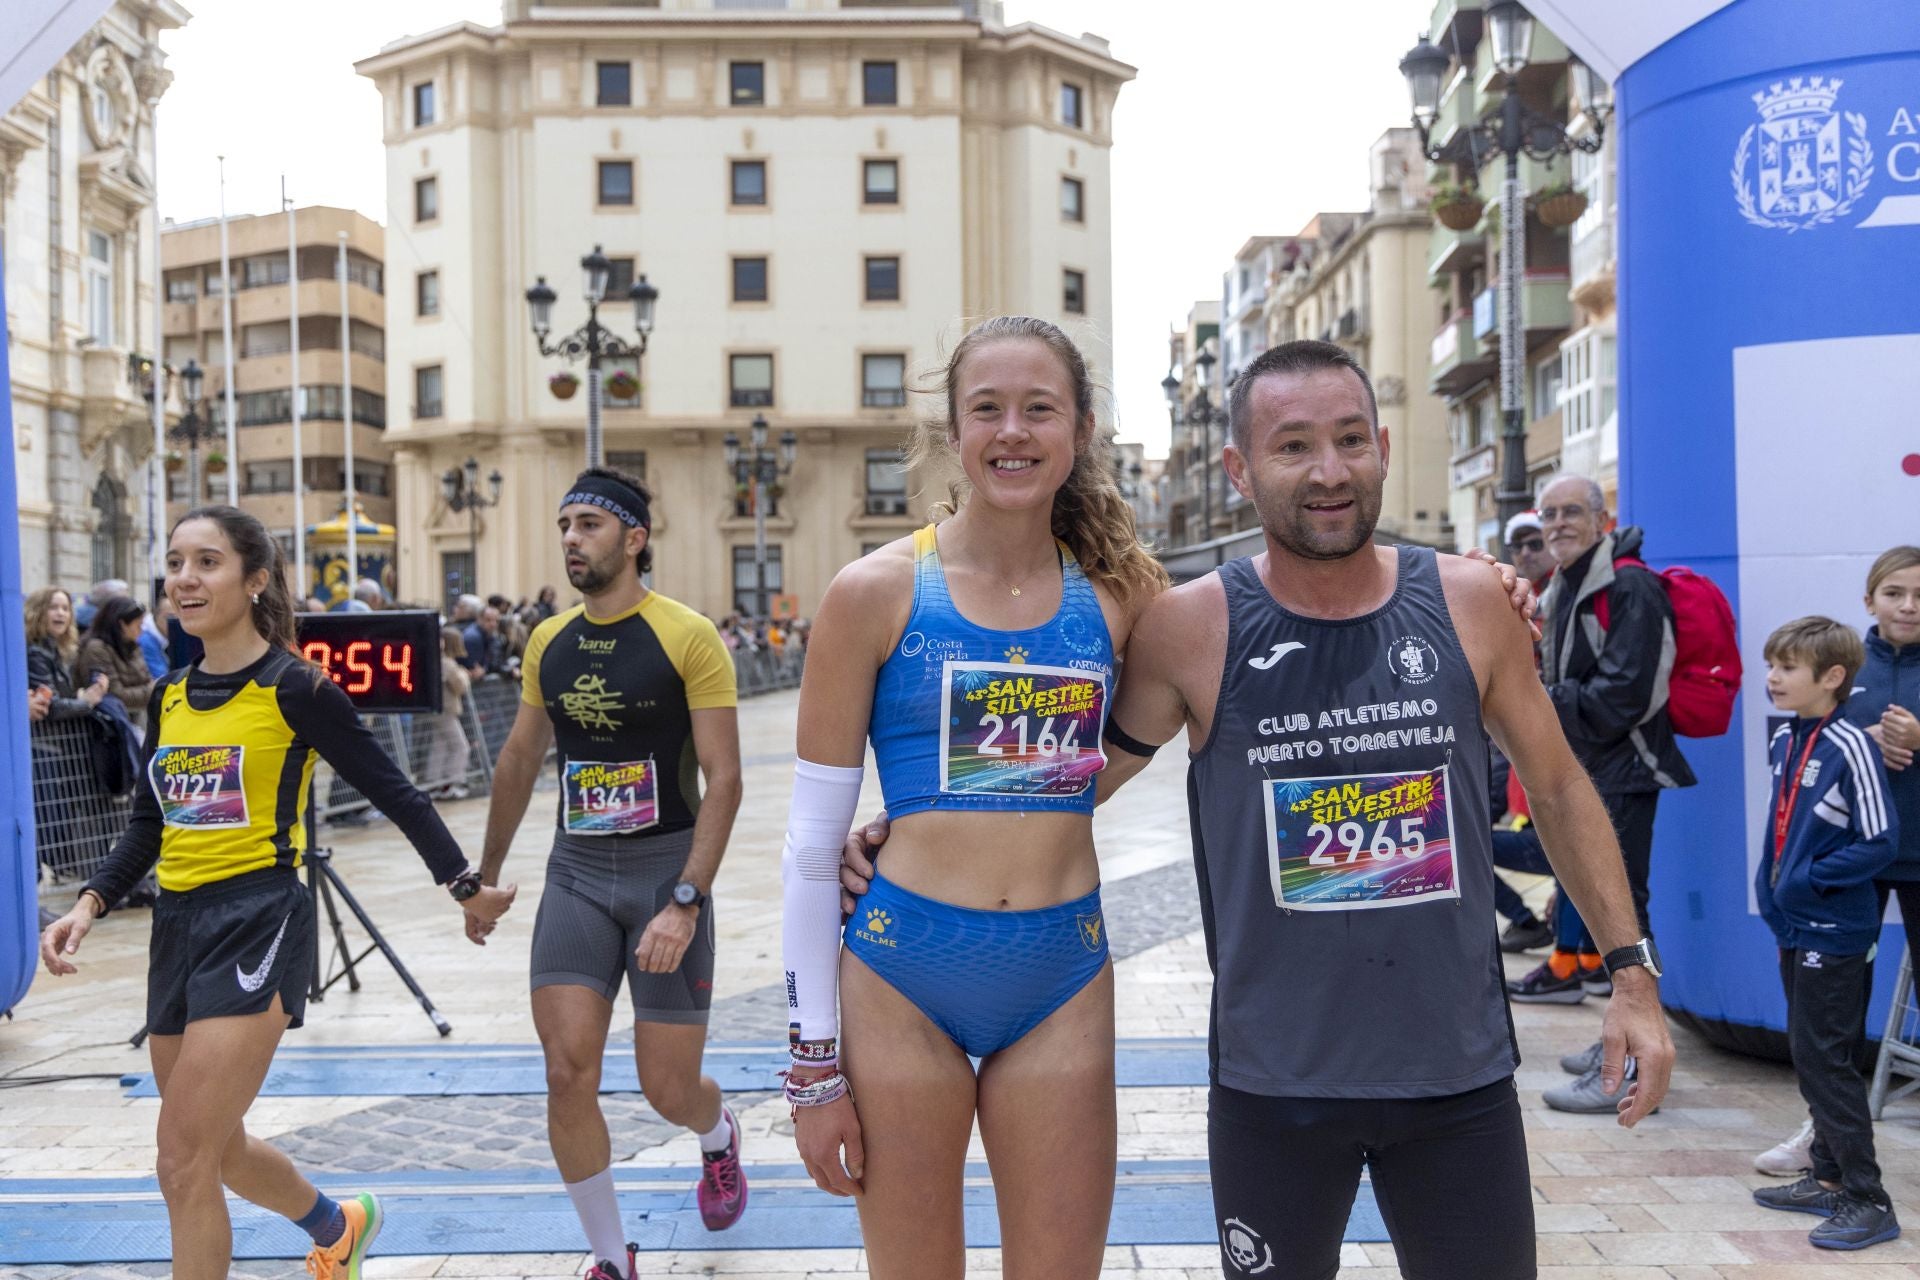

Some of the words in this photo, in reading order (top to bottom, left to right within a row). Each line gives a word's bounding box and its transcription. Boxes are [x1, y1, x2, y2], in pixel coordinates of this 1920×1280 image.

[927, 638, 963, 650] Costa
[986, 682, 1096, 716] SILVESTRE
[988, 677, 1033, 699] SAN
[1036, 701, 1094, 718] CARTAGENA
[1257, 713, 1310, 736] CLUB
[1317, 698, 1438, 729] ATLETISMO
[977, 714, 1080, 760] 2164
[1247, 739, 1323, 765] PUERTO
[1329, 725, 1456, 755] TORREVIEJA
[165, 748, 231, 775] SILVESTRE
[166, 749, 189, 765] SAN
[580, 765, 605, 779] SAN
[580, 763, 645, 789] SILVESTRE
[164, 773, 223, 801] 2727
[578, 786, 636, 811] 1341
[1311, 775, 1434, 825] SILVESTRE
[1312, 781, 1361, 808] SAN
[1366, 794, 1434, 822] CARTAGENA
[1306, 817, 1425, 865] 2965
[855, 928, 897, 948] KELME
